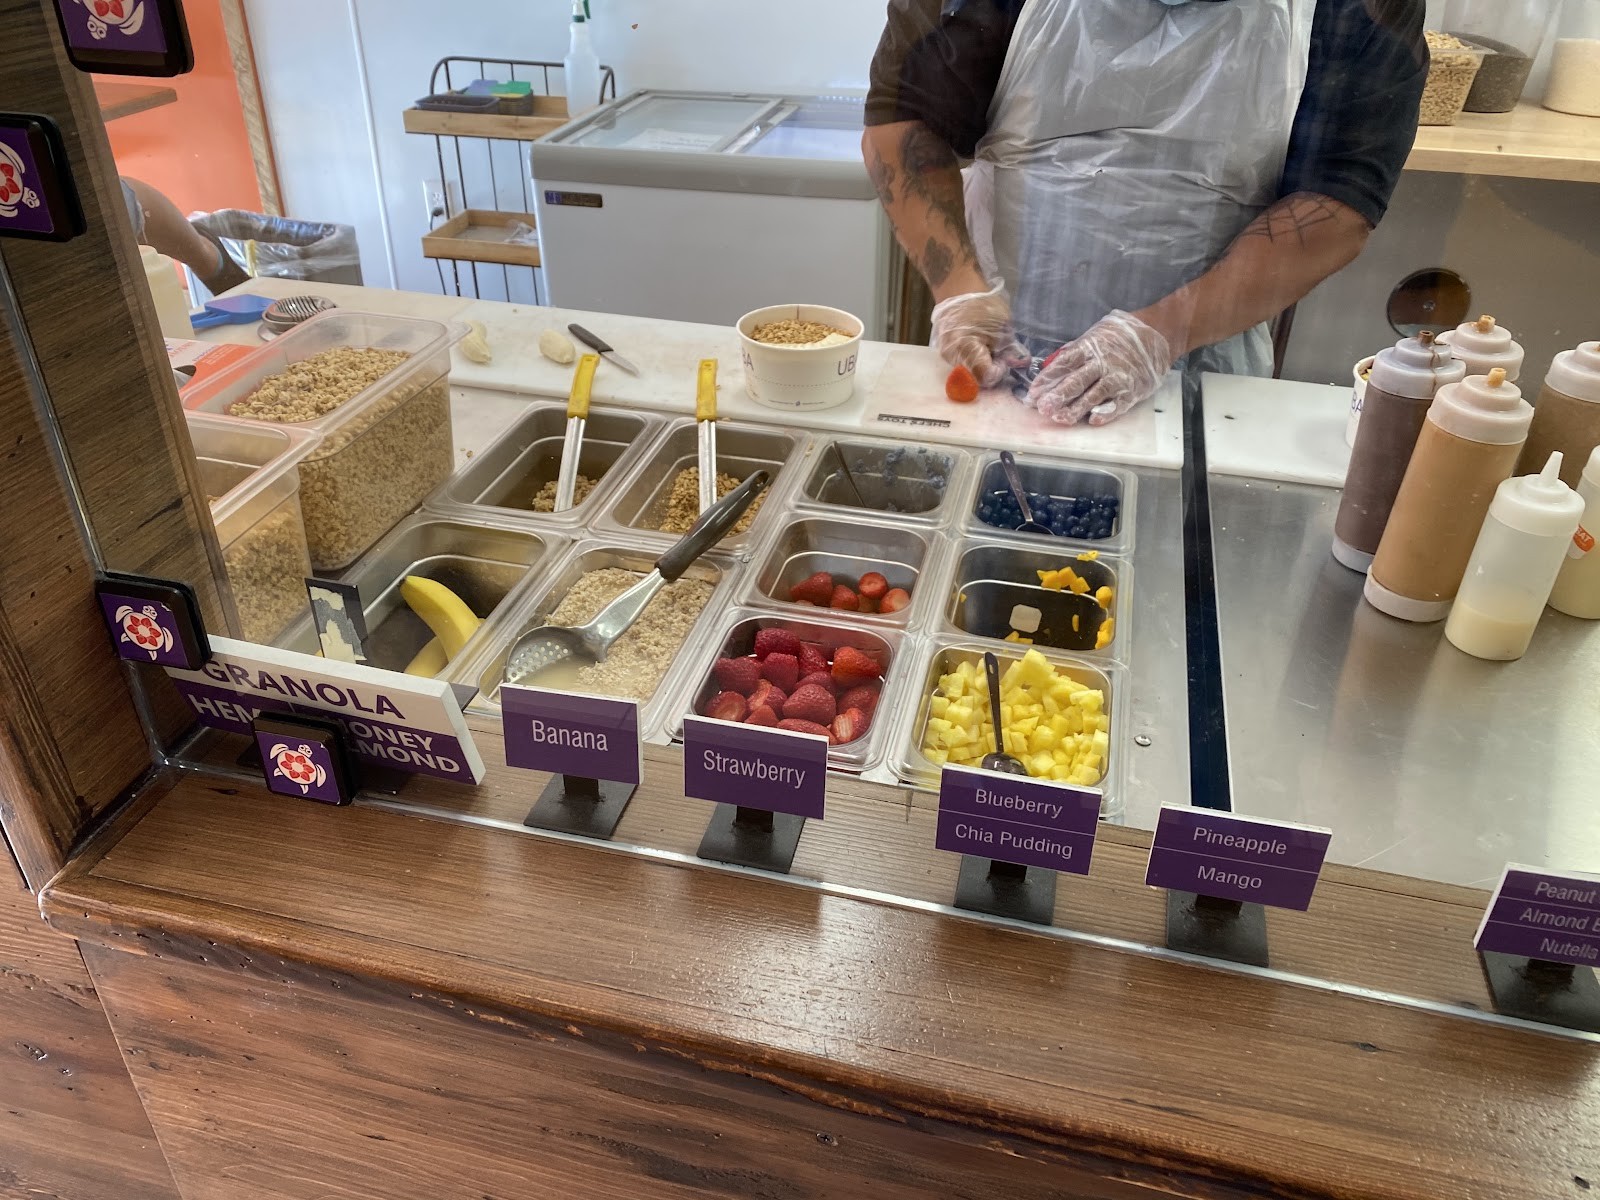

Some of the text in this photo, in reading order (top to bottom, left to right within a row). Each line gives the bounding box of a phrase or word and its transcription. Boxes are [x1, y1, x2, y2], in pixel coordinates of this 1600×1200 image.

[202, 660, 405, 719] GRANOLA
[187, 693, 261, 724] HEM
[532, 719, 608, 751] Banana
[346, 737, 460, 773] MOND
[703, 750, 806, 789] Strawberry
[975, 788, 1063, 819] Blueberry
[955, 823, 1073, 859] Chia Pudding
[1193, 827, 1287, 855] Pineapple
[1197, 865, 1262, 889] Mango
[1534, 881, 1597, 904] Peanut
[1519, 907, 1590, 930] Almond
[1539, 938, 1599, 960] Nutella
